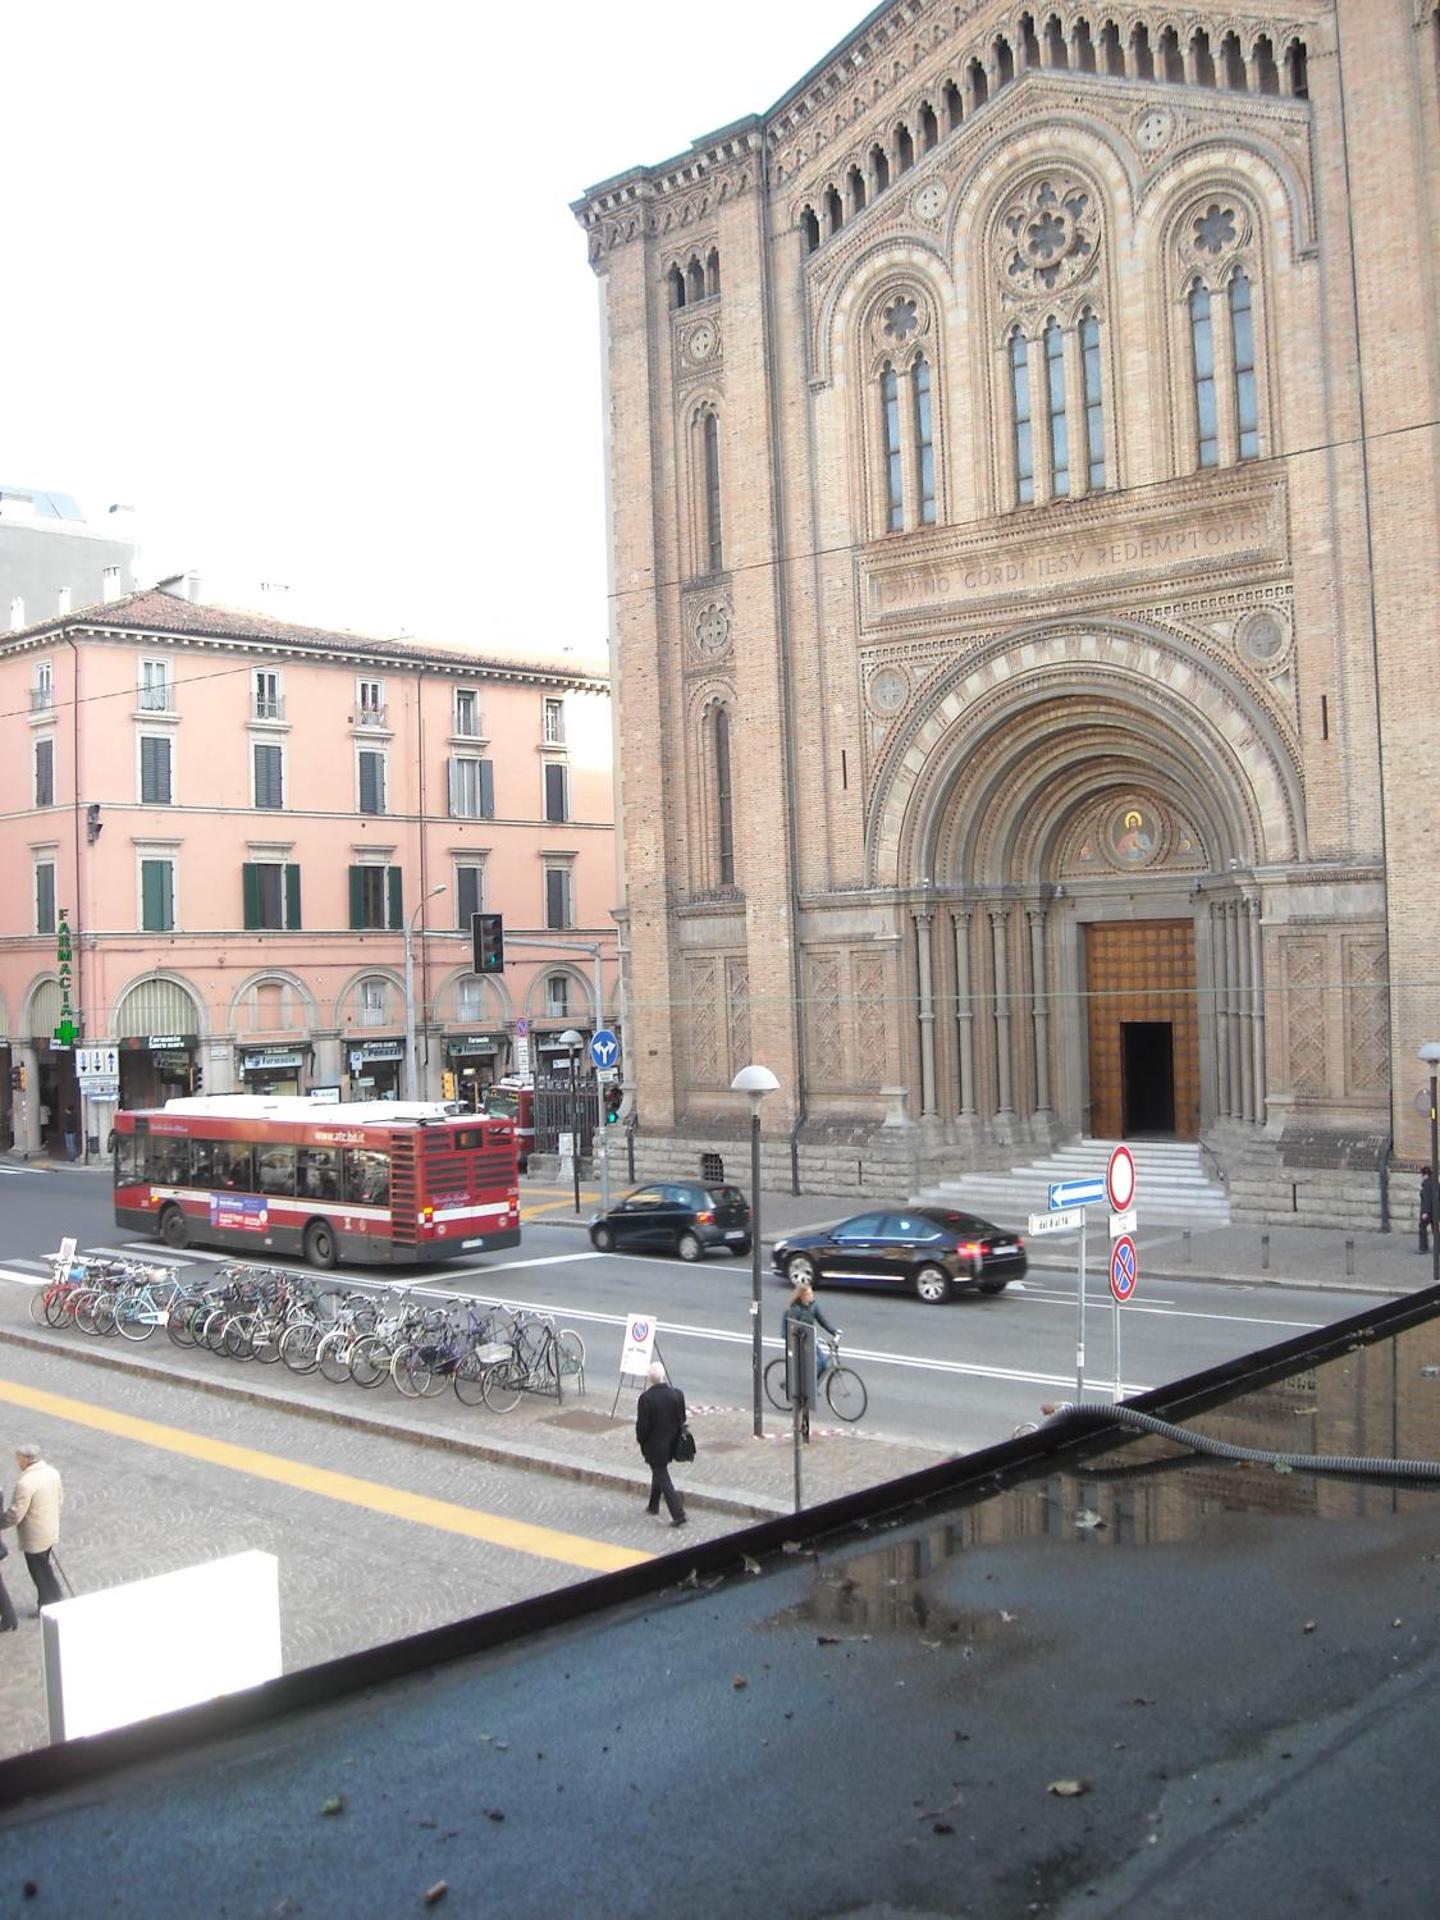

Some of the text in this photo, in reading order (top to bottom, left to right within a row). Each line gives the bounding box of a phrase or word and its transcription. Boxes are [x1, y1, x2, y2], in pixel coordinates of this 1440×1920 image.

[964, 562, 1025, 589] CORDI
[1038, 551, 1085, 577] IESV
[1096, 519, 1262, 565] REDEMPTORIS
[57, 908, 73, 1016] FARMACIA
